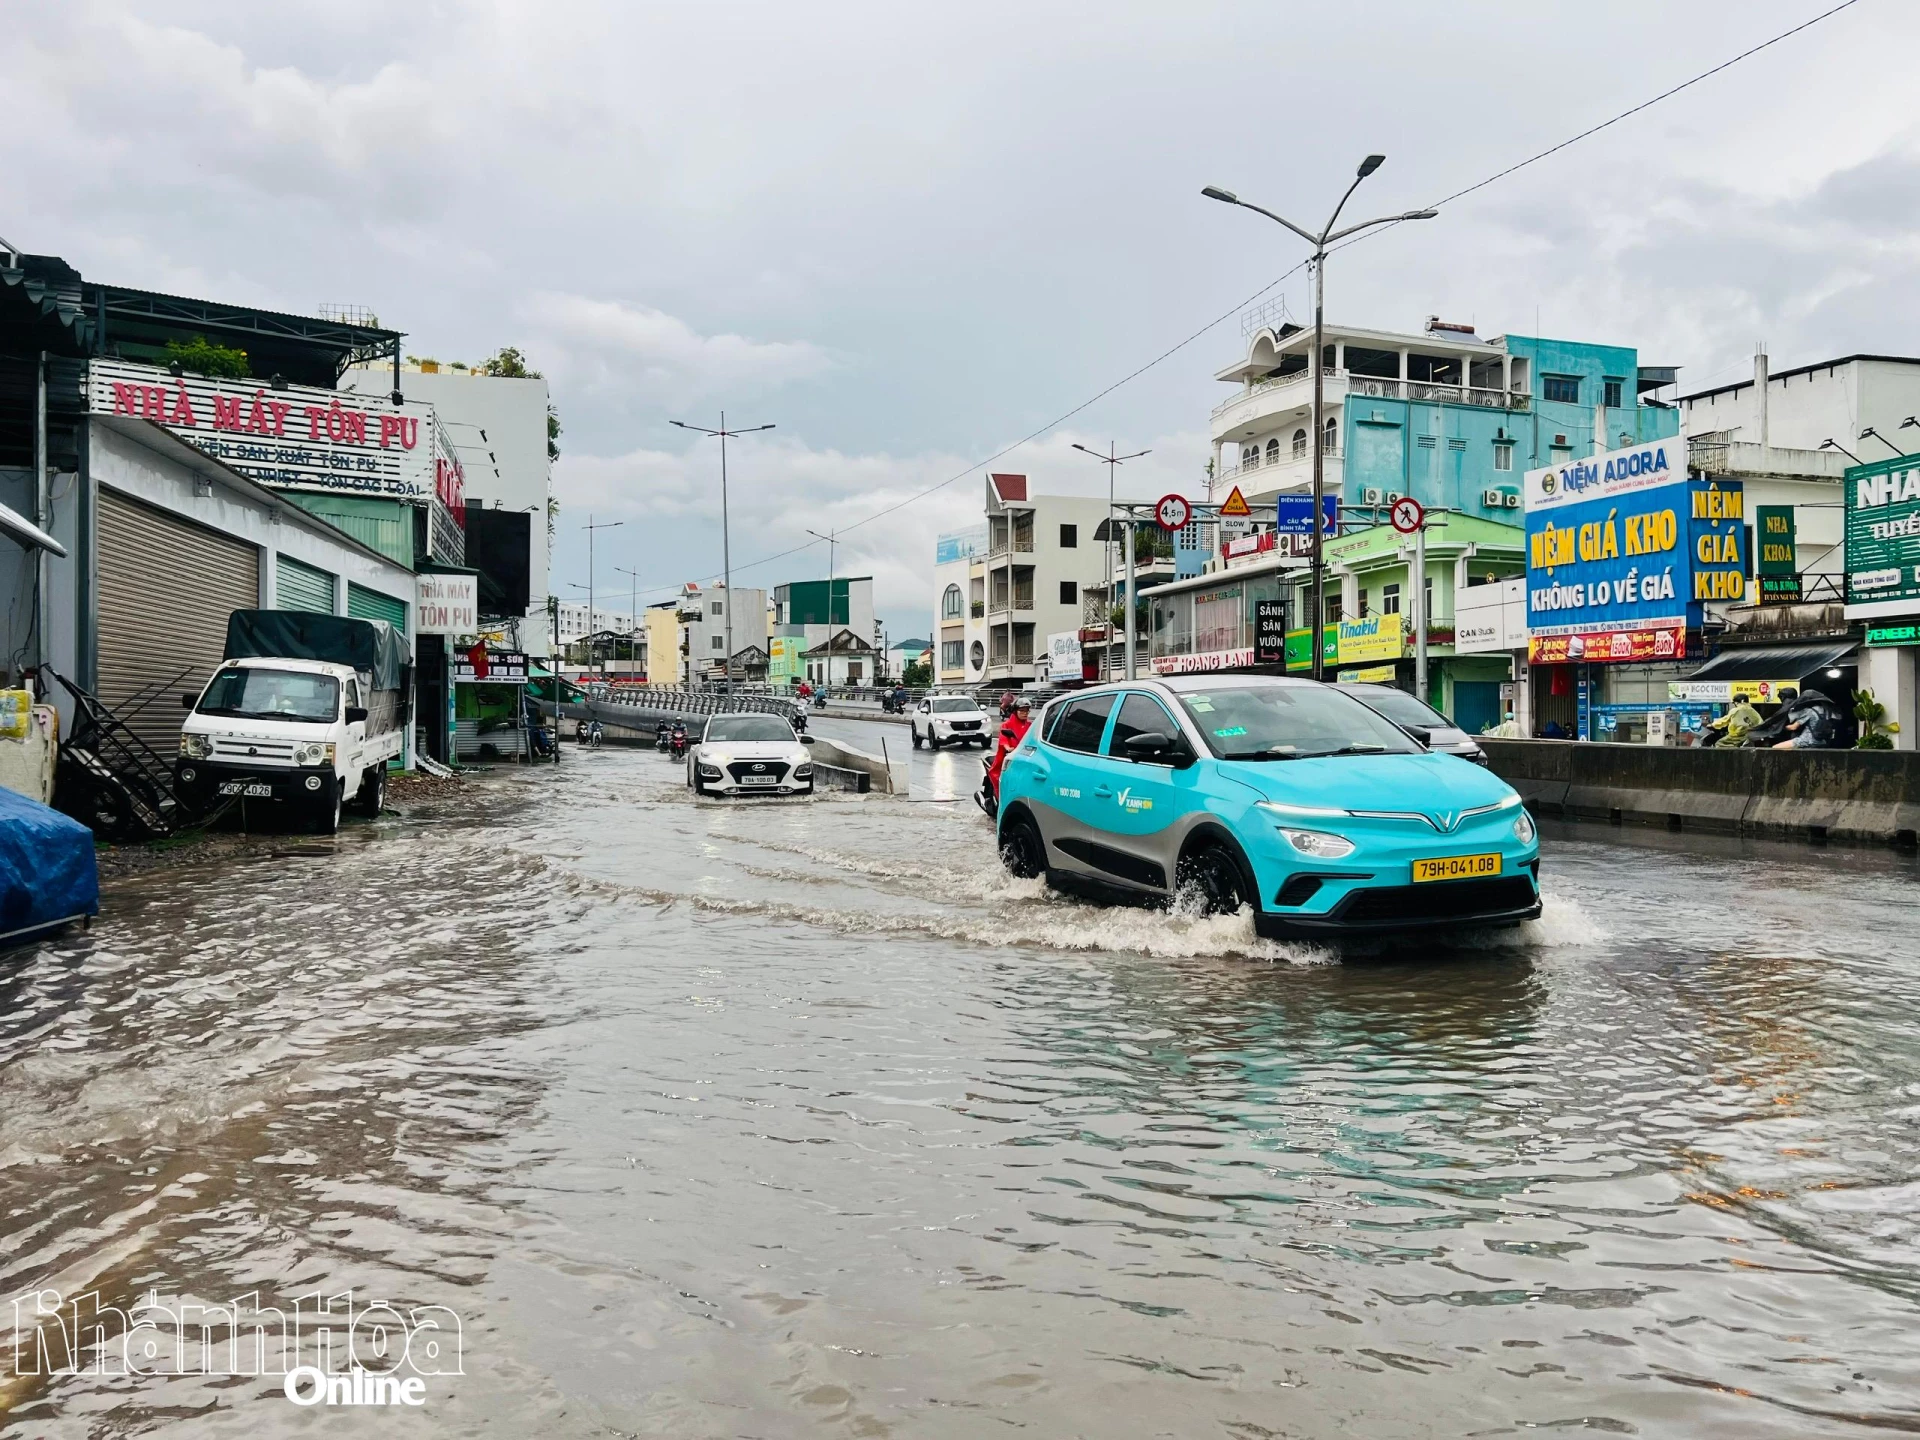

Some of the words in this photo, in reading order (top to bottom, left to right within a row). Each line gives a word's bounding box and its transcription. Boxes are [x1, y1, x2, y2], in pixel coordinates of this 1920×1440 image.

[112, 379, 196, 426] NHÀ
[212, 389, 292, 436] MÁY
[304, 399, 367, 444] TÔN
[379, 414, 418, 450] PU
[320, 452, 350, 469] TÔN
[357, 457, 376, 471] PU
[1563, 461, 1599, 494] NỆM
[1604, 448, 1670, 483] ADORA
[387, 481, 421, 497] LOẠI
[1691, 482, 1743, 528] NỆM
[1226, 520, 1245, 528] SLOW
[1766, 516, 1788, 533] NHA
[1870, 510, 1920, 539] TUYẾ
[1530, 521, 1576, 577] NỆM
[1579, 507, 1618, 562] GIÁ
[1625, 509, 1677, 556] KHO
[1697, 524, 1739, 564] GIÁ
[1764, 544, 1792, 561] KHOA
[447, 581, 471, 599] MÁY
[1531, 581, 1585, 613] KHÔNG
[1589, 581, 1611, 607] LO
[1613, 567, 1637, 604] VỀ
[1641, 566, 1675, 601] GIÁ
[1694, 570, 1744, 600] KHO
[1763, 581, 1778, 591] NHA
[1780, 581, 1799, 591] KHOA
[419, 602, 448, 627] TÔN
[453, 607, 472, 628] PU
[1260, 603, 1284, 616] SẢNH
[1262, 620, 1281, 631] SÂN
[1340, 618, 1379, 639] Tinakid
[1460, 628, 1476, 638] CAN
[1867, 626, 1916, 642] VENEER
[1260, 636, 1284, 647] VƯỜN
[1420, 857, 1494, 878] 79H-041.08
